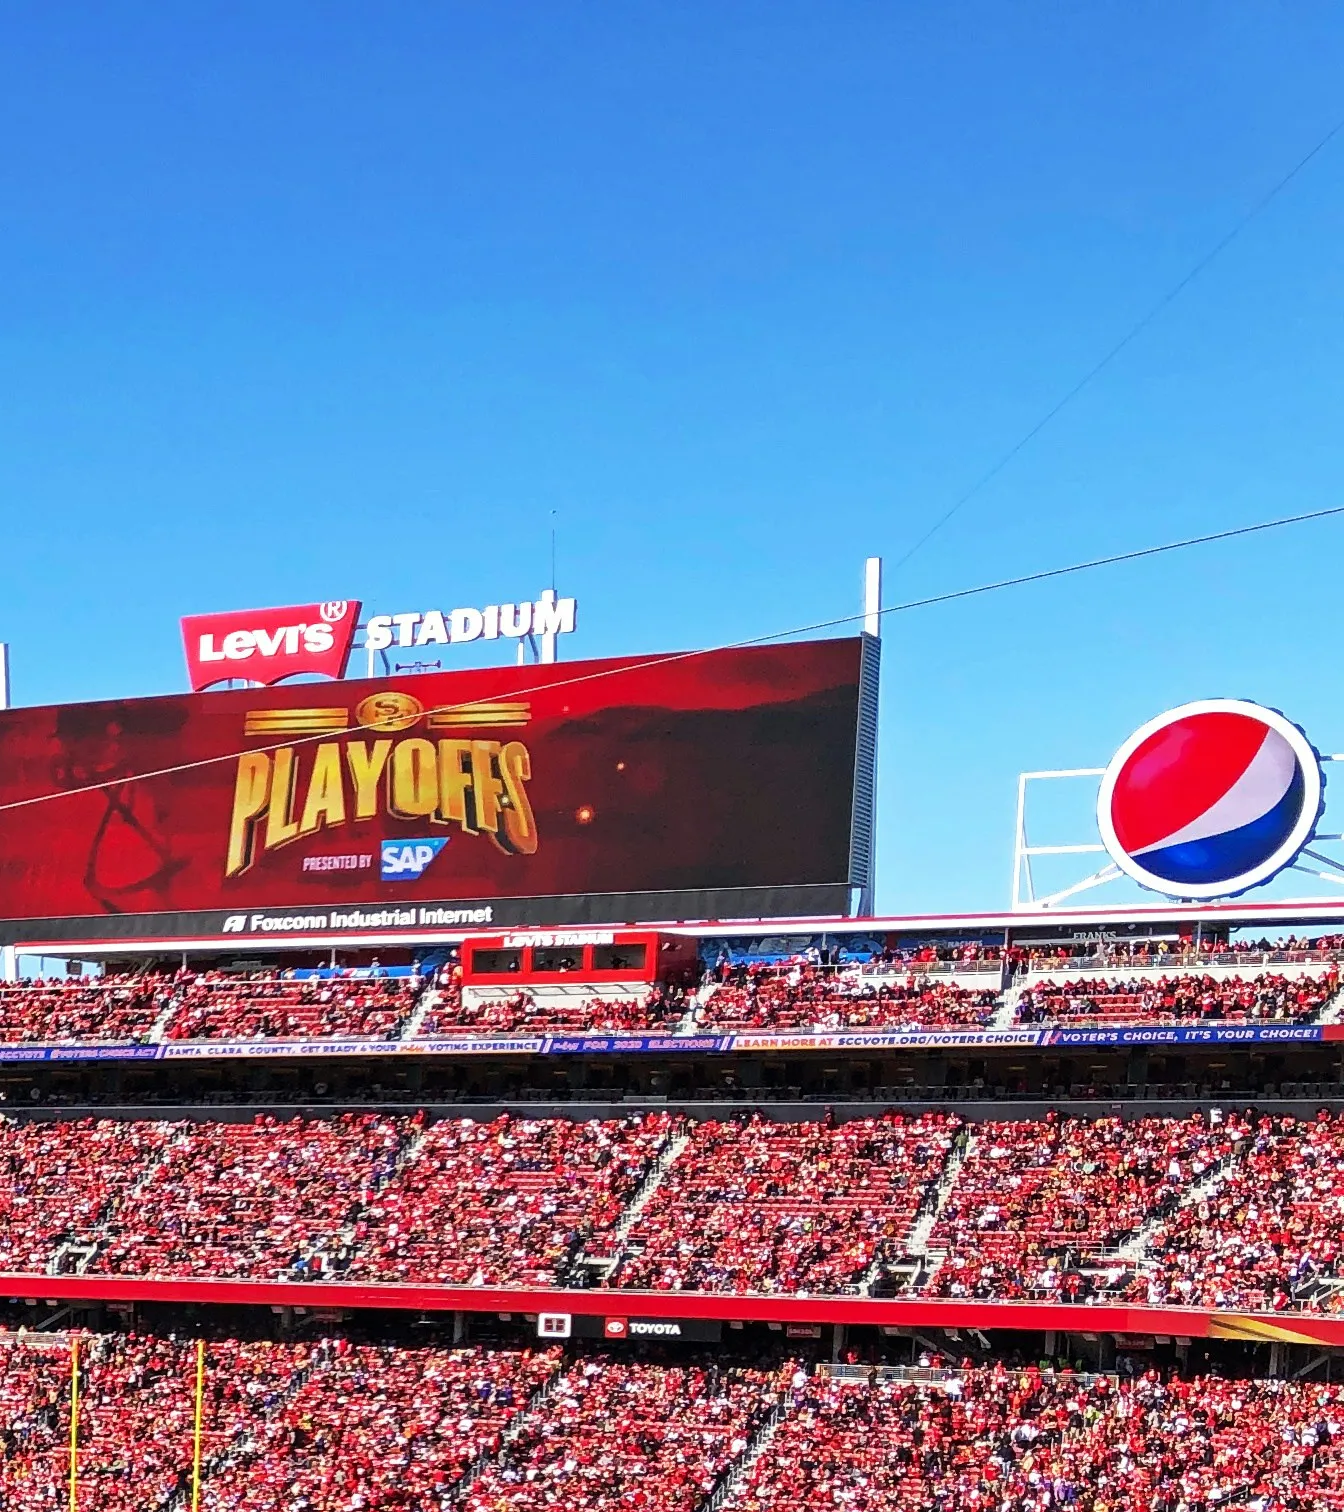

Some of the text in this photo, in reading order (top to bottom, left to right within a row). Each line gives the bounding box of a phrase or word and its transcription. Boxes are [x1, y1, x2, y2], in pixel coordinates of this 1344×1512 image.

[365, 598, 578, 651] STADIUM
[224, 737, 539, 880] PLAYOFFS
[302, 854, 373, 872] PRESENTED BY
[381, 845, 433, 875] SAP
[250, 914, 328, 932] Foxconn
[330, 908, 416, 929] Industrial
[419, 905, 494, 925] Internet
[736, 1038, 779, 1048] LEARN
[781, 1038, 816, 1047] MORE
[818, 1037, 834, 1047] AT
[1063, 1029, 1319, 1042] VOTER'S CHOICE, IT'S YOUR CHOICE!
[168, 1047, 201, 1056] SANTA
[207, 1047, 242, 1055] CLARA
[300, 1045, 323, 1054] GET
[323, 1044, 357, 1054] READY
[369, 1044, 397, 1053] YOUR
[429, 1043, 469, 1052] VOTING
[471, 1042, 538, 1051] EXPERIENCE
[628, 1322, 682, 1336] TOYOTA
